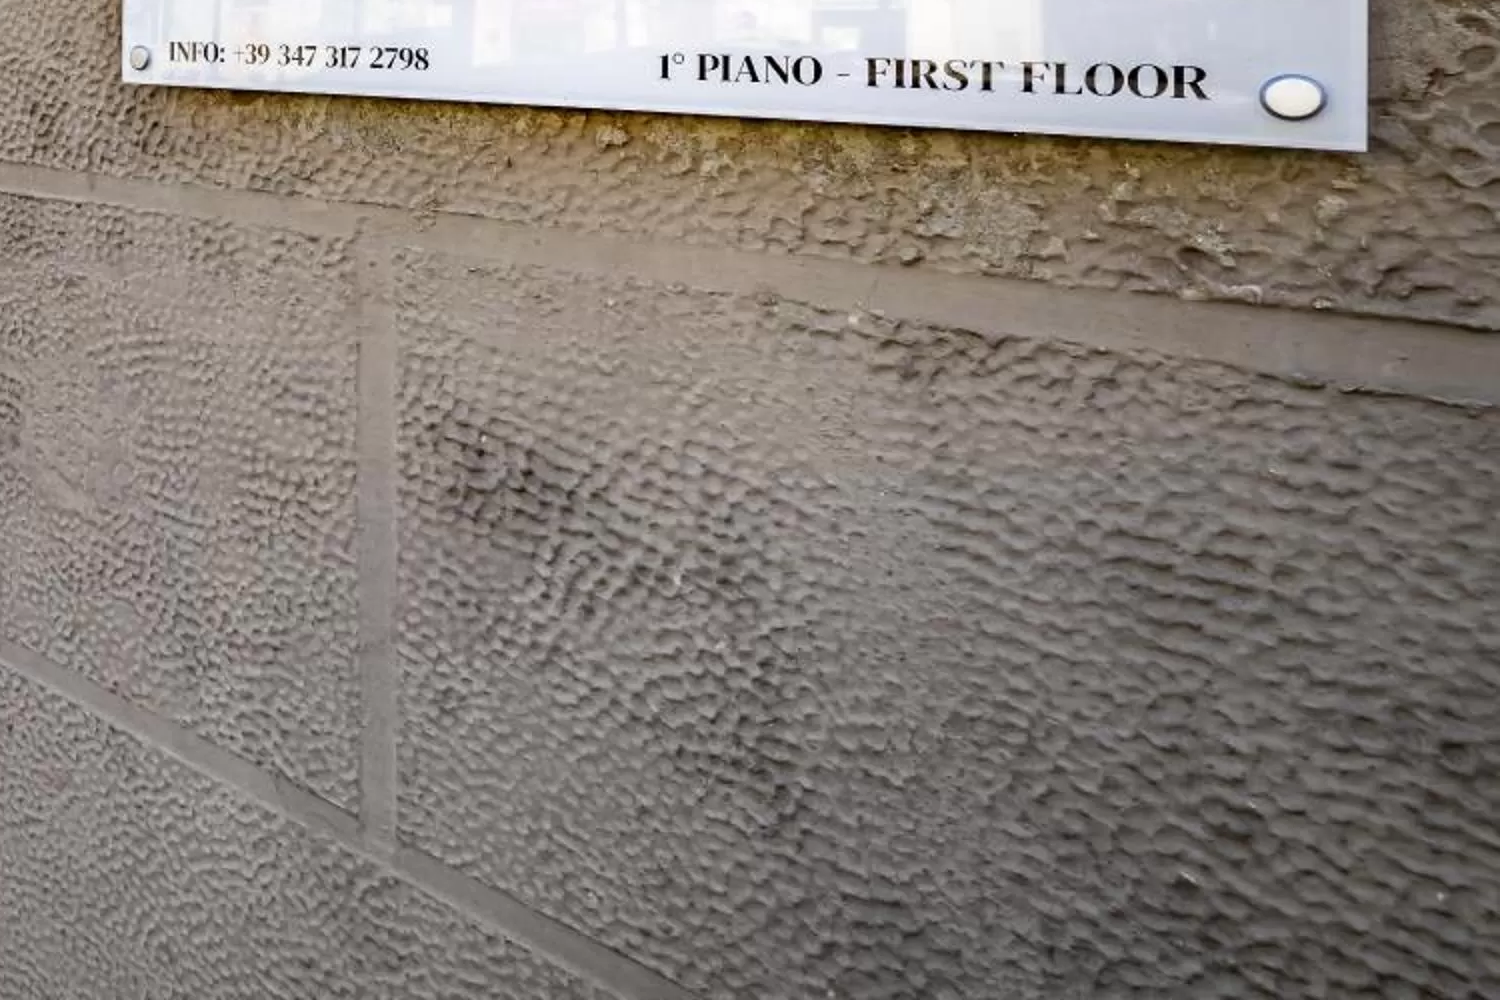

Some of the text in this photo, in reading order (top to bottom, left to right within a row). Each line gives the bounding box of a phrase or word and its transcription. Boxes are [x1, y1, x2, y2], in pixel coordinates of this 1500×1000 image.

[168, 41, 430, 71] INFO: +39 347 317 2798
[696, 53, 823, 86] PIANO
[866, 56, 1007, 93] FIRST
[1021, 60, 1211, 101] FLOOR
